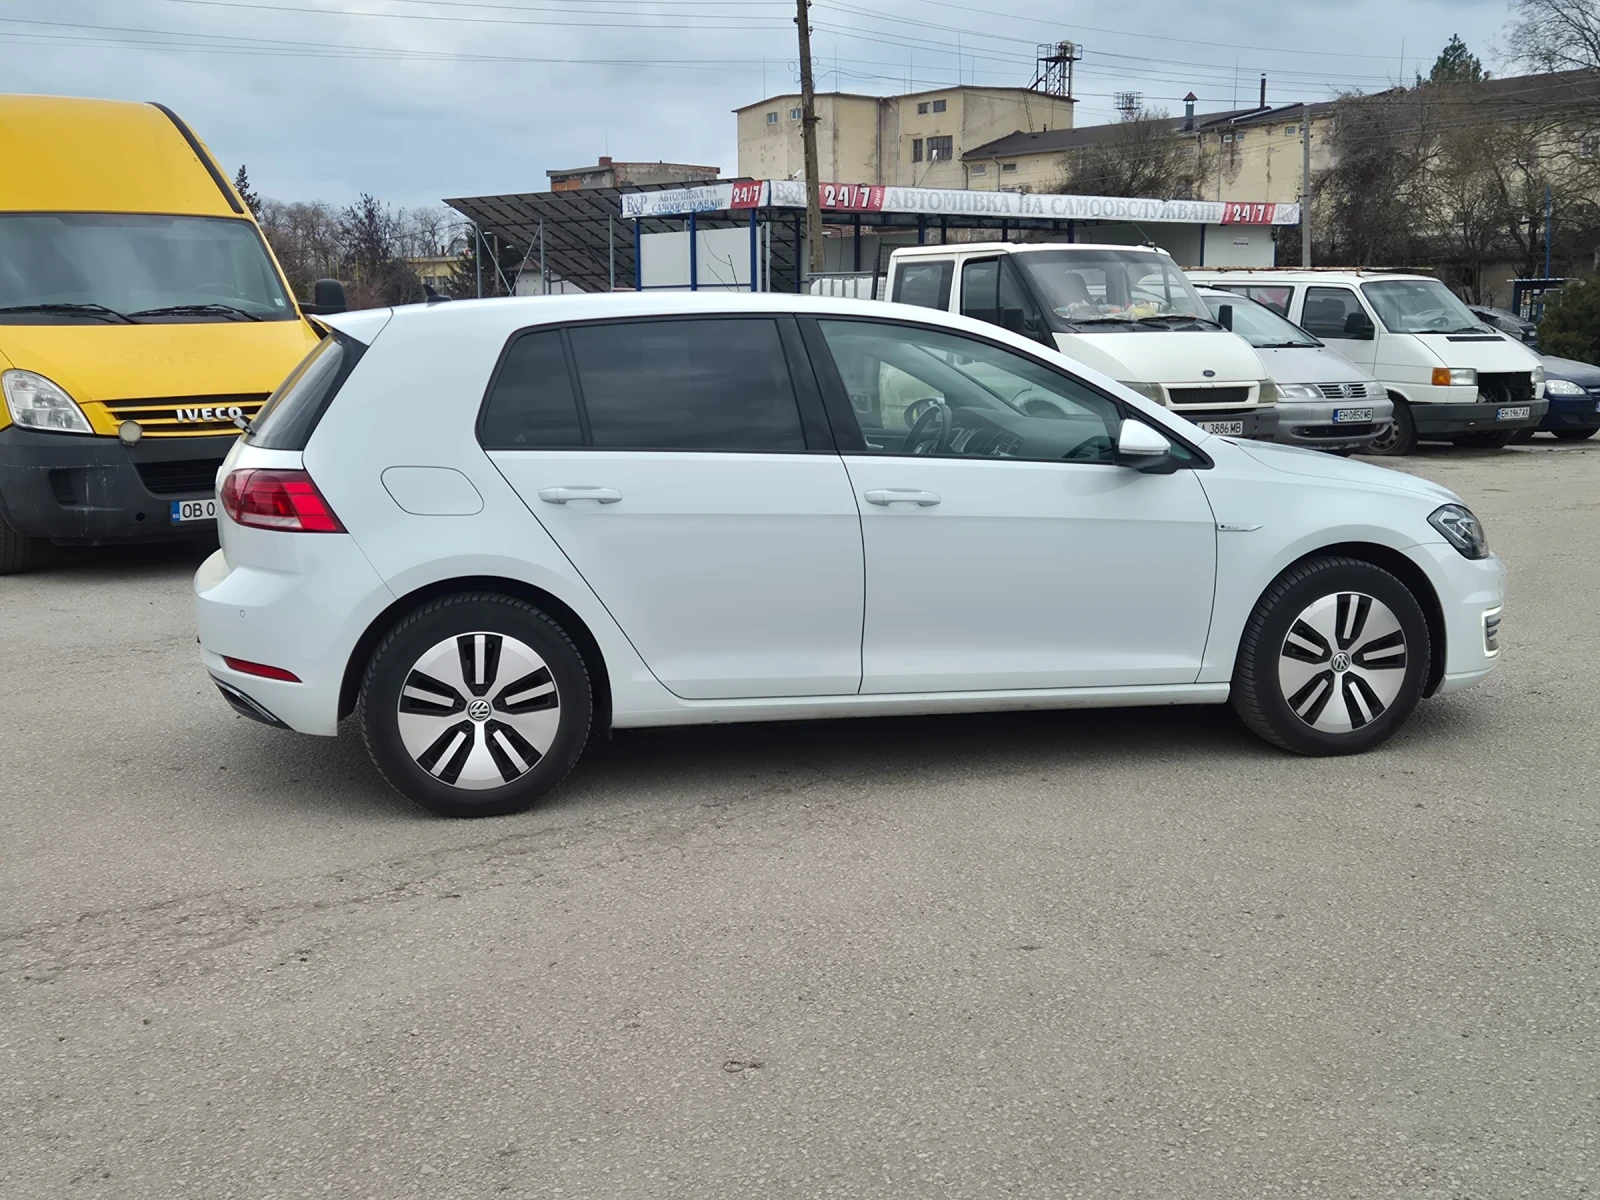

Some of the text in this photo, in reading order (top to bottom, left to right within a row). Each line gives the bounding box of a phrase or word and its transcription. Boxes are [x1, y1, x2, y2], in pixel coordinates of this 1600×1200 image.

[658, 188, 718, 202] АВТОМИВКА НА
[733, 184, 760, 203] 24/7
[774, 182, 806, 204] B&P
[825, 185, 871, 208] 24/7
[651, 198, 725, 213] САМООБСЛУЖВАНЕ
[887, 189, 1221, 222] АВТОМИВКА НА САМООБСЛУЖВАНЕ
[1233, 203, 1265, 222] 24/7
[175, 406, 243, 422] IVECO
[1210, 423, 1230, 434] 3886
